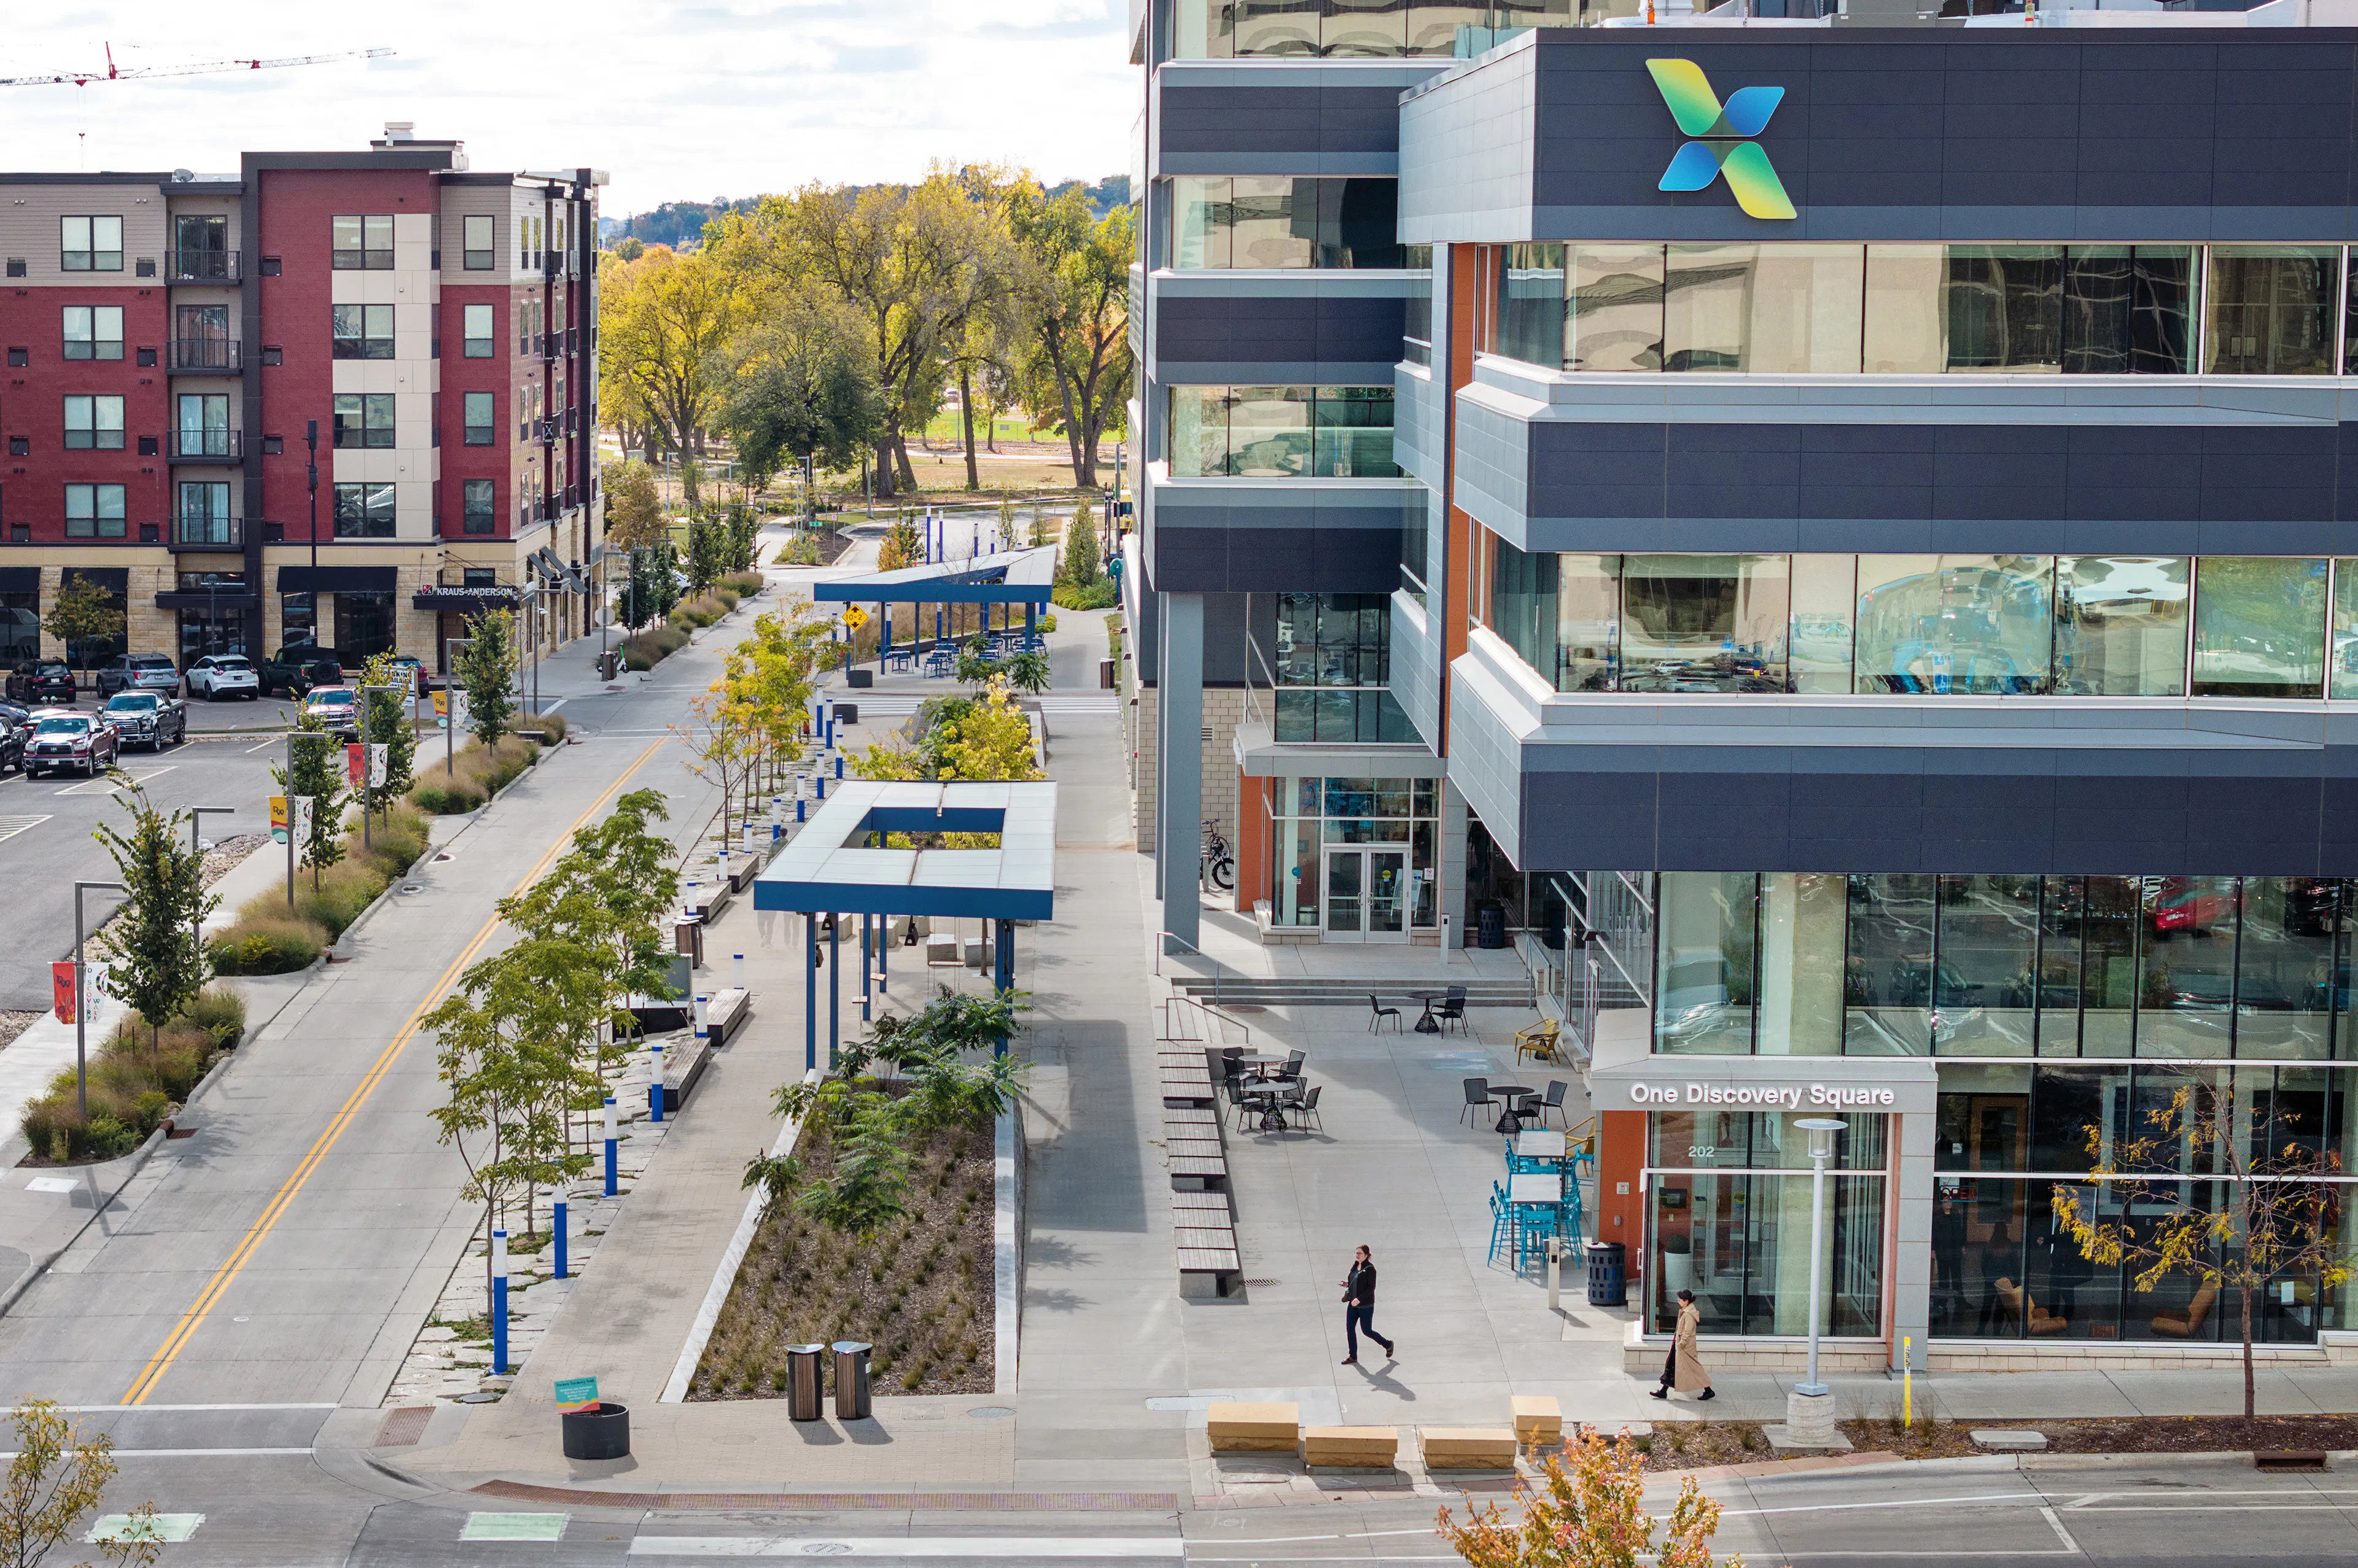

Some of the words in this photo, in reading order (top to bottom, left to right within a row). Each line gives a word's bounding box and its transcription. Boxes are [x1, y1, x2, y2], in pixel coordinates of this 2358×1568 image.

[437, 588, 513, 596] KRAUS-ANDERSON
[1630, 1082, 1679, 1103] One
[1686, 1082, 1803, 1109] Discovery
[1810, 1083, 1894, 1109] Square
[1688, 1146, 1714, 1158] 202
[1942, 1187, 1977, 1200] OPEN
